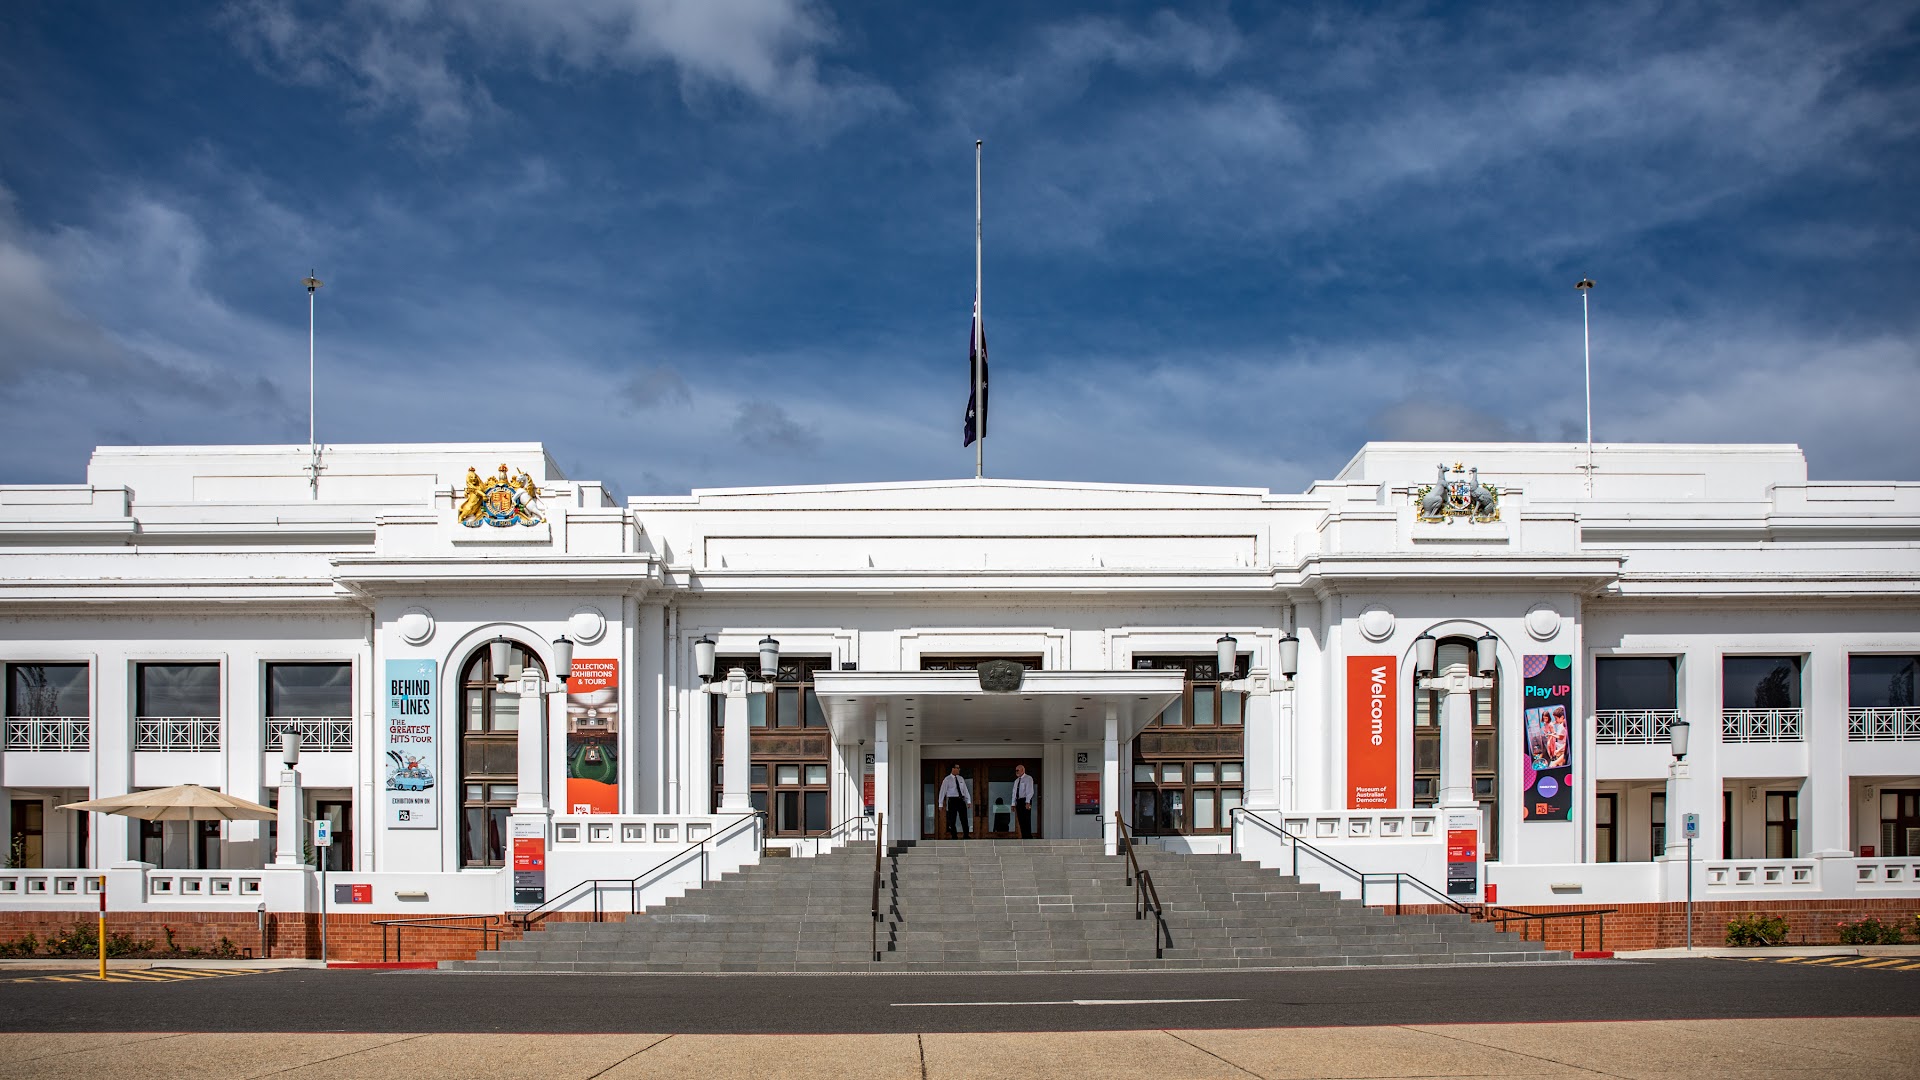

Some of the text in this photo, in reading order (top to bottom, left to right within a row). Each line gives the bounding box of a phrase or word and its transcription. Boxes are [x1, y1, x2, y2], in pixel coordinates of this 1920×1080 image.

[392, 680, 430, 696] BEHIND
[1525, 685, 1570, 699] PlayUP
[400, 699, 430, 714] LINES
[1371, 666, 1386, 746] Welcome
[390, 726, 430, 734] GREATEST
[391, 735, 410, 743] HITS
